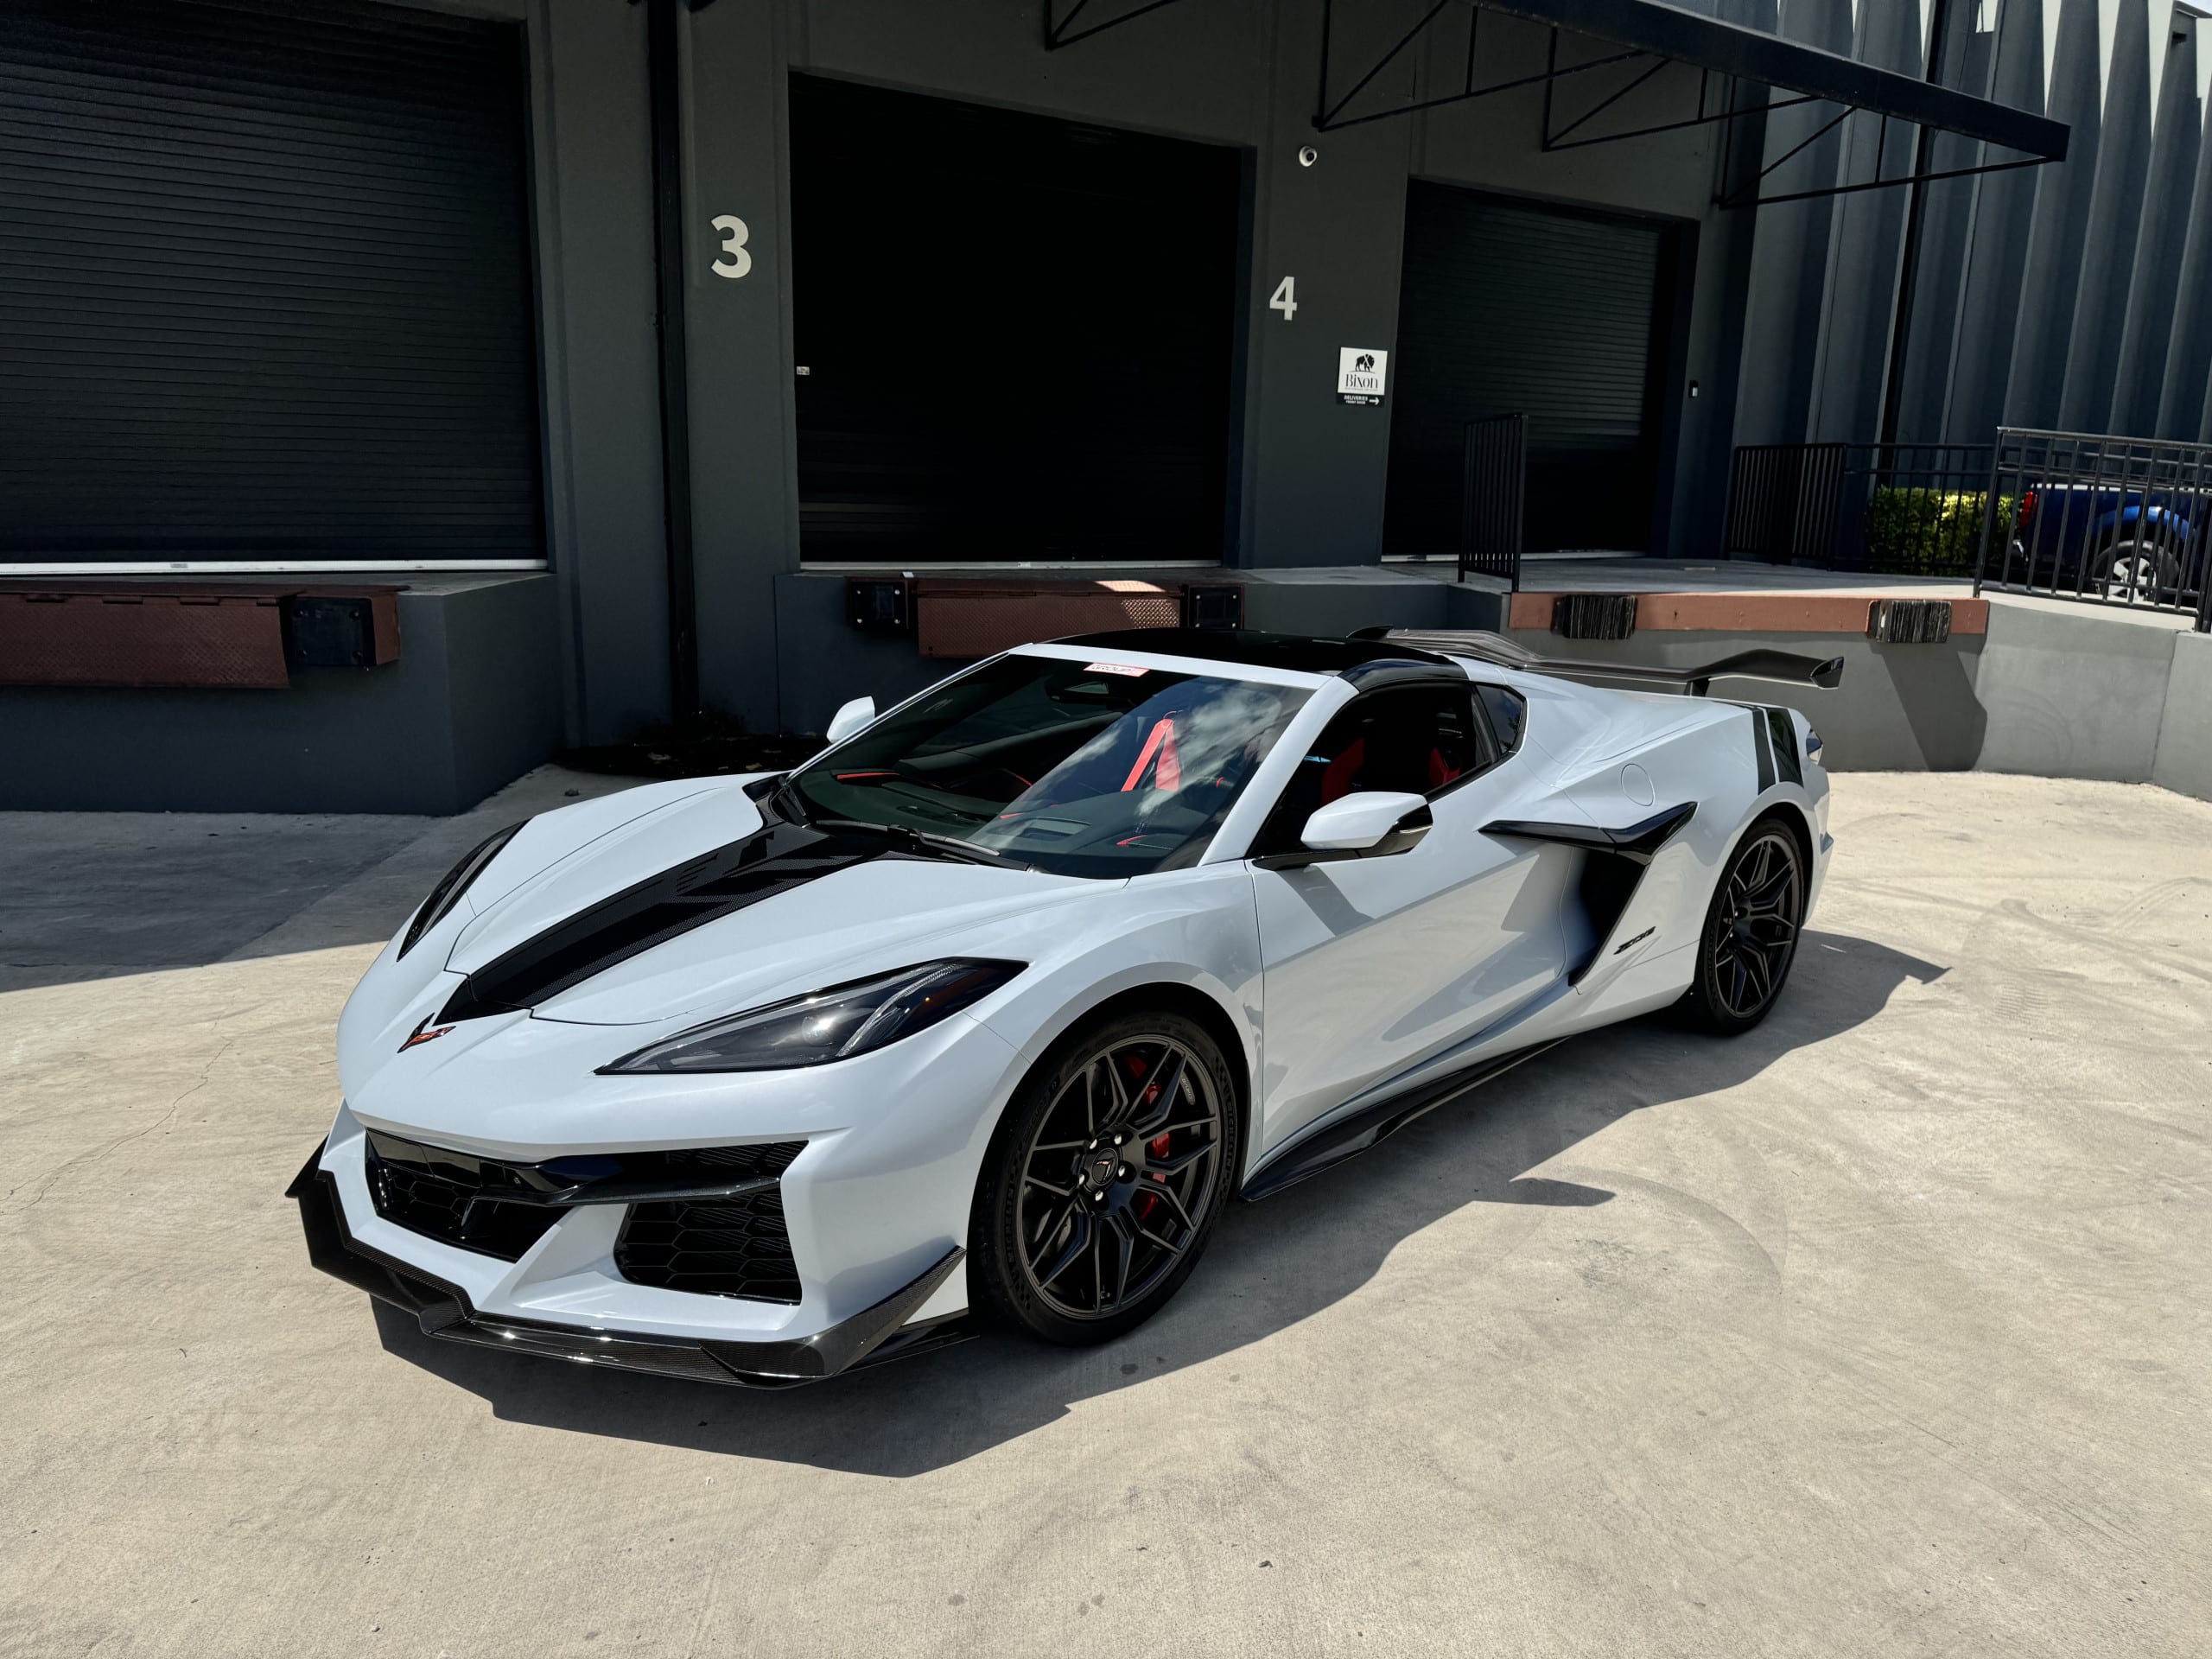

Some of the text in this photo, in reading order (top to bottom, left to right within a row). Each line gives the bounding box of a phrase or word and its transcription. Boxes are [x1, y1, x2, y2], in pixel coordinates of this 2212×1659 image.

[711, 214, 752, 278] 3
[1269, 276, 1298, 321] 4
[1345, 373, 1378, 389] Bixon
